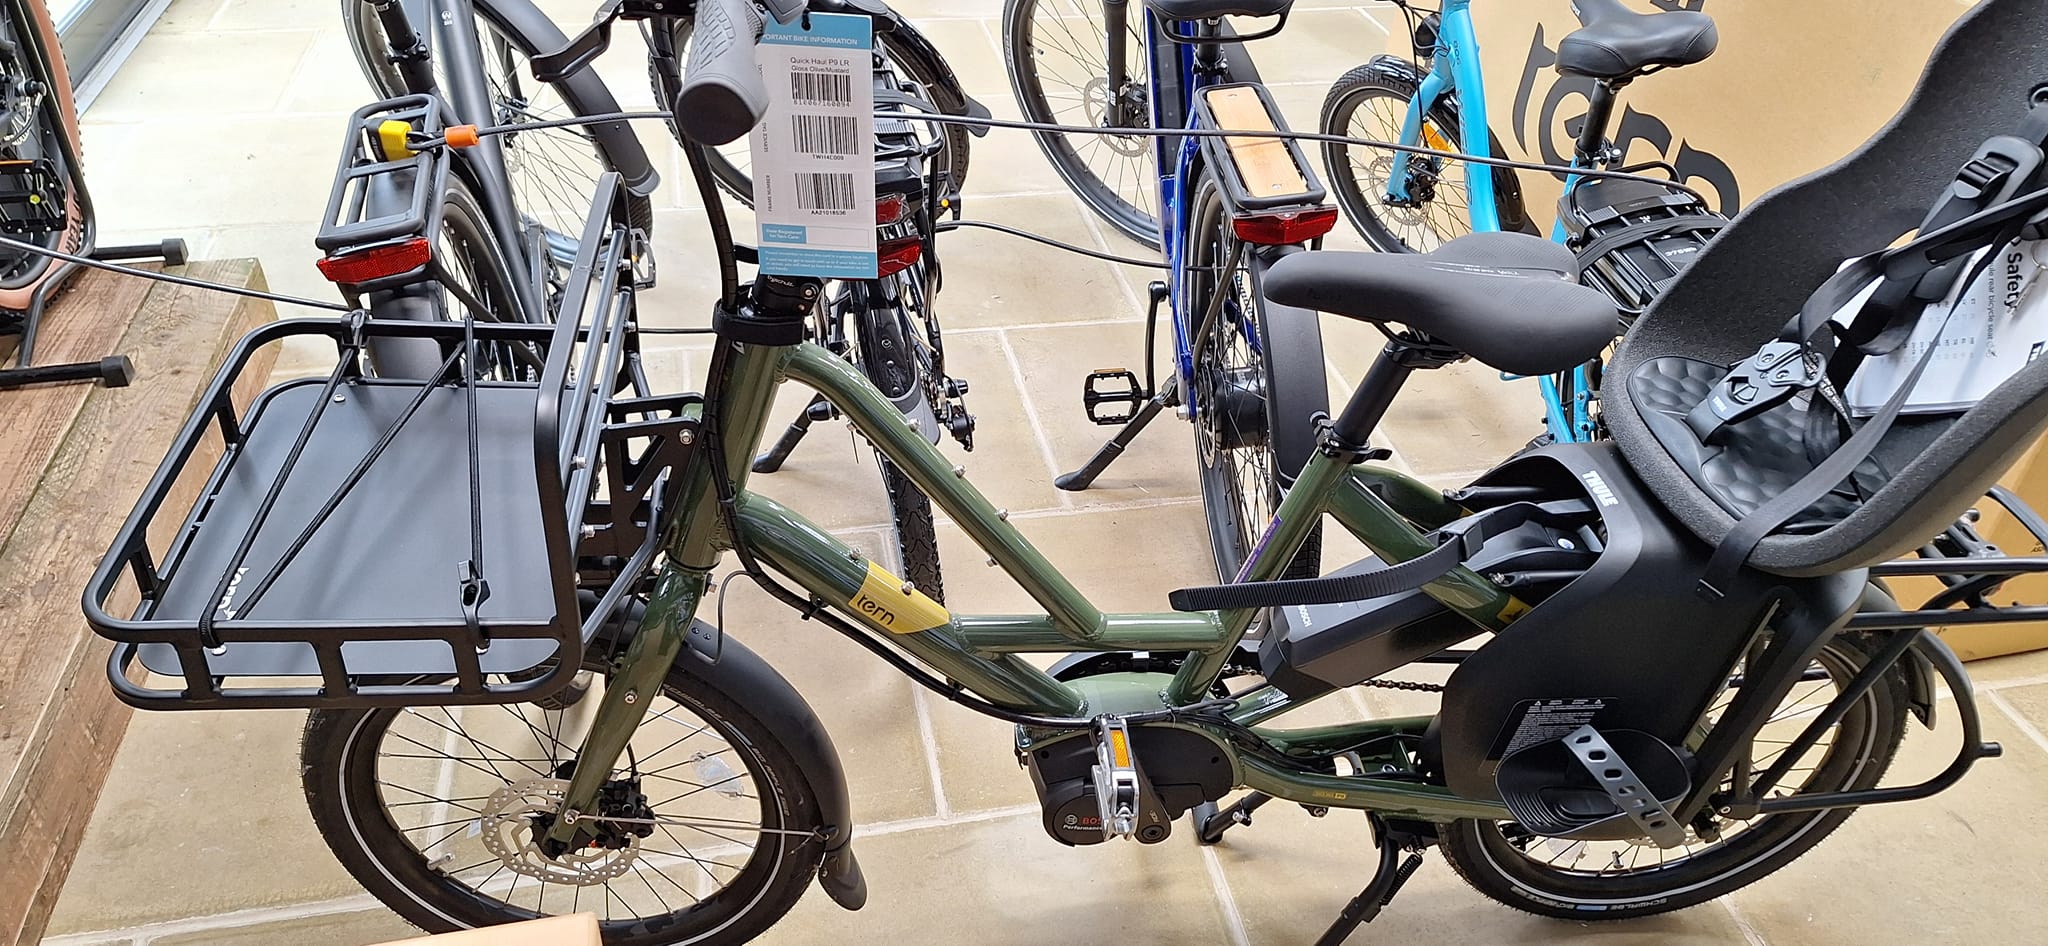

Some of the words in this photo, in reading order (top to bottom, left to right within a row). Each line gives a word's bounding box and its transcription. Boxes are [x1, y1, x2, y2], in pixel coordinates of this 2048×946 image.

[793, 35, 809, 43] BIKE
[810, 36, 857, 45] INFORMATION
[790, 56, 810, 65] Quick
[2005, 252, 2023, 308] Safety
[1987, 295, 1995, 322] bicycle
[1581, 470, 1619, 507] THULE
[856, 595, 895, 626] tern
[1298, 604, 1313, 628] BOSCH
